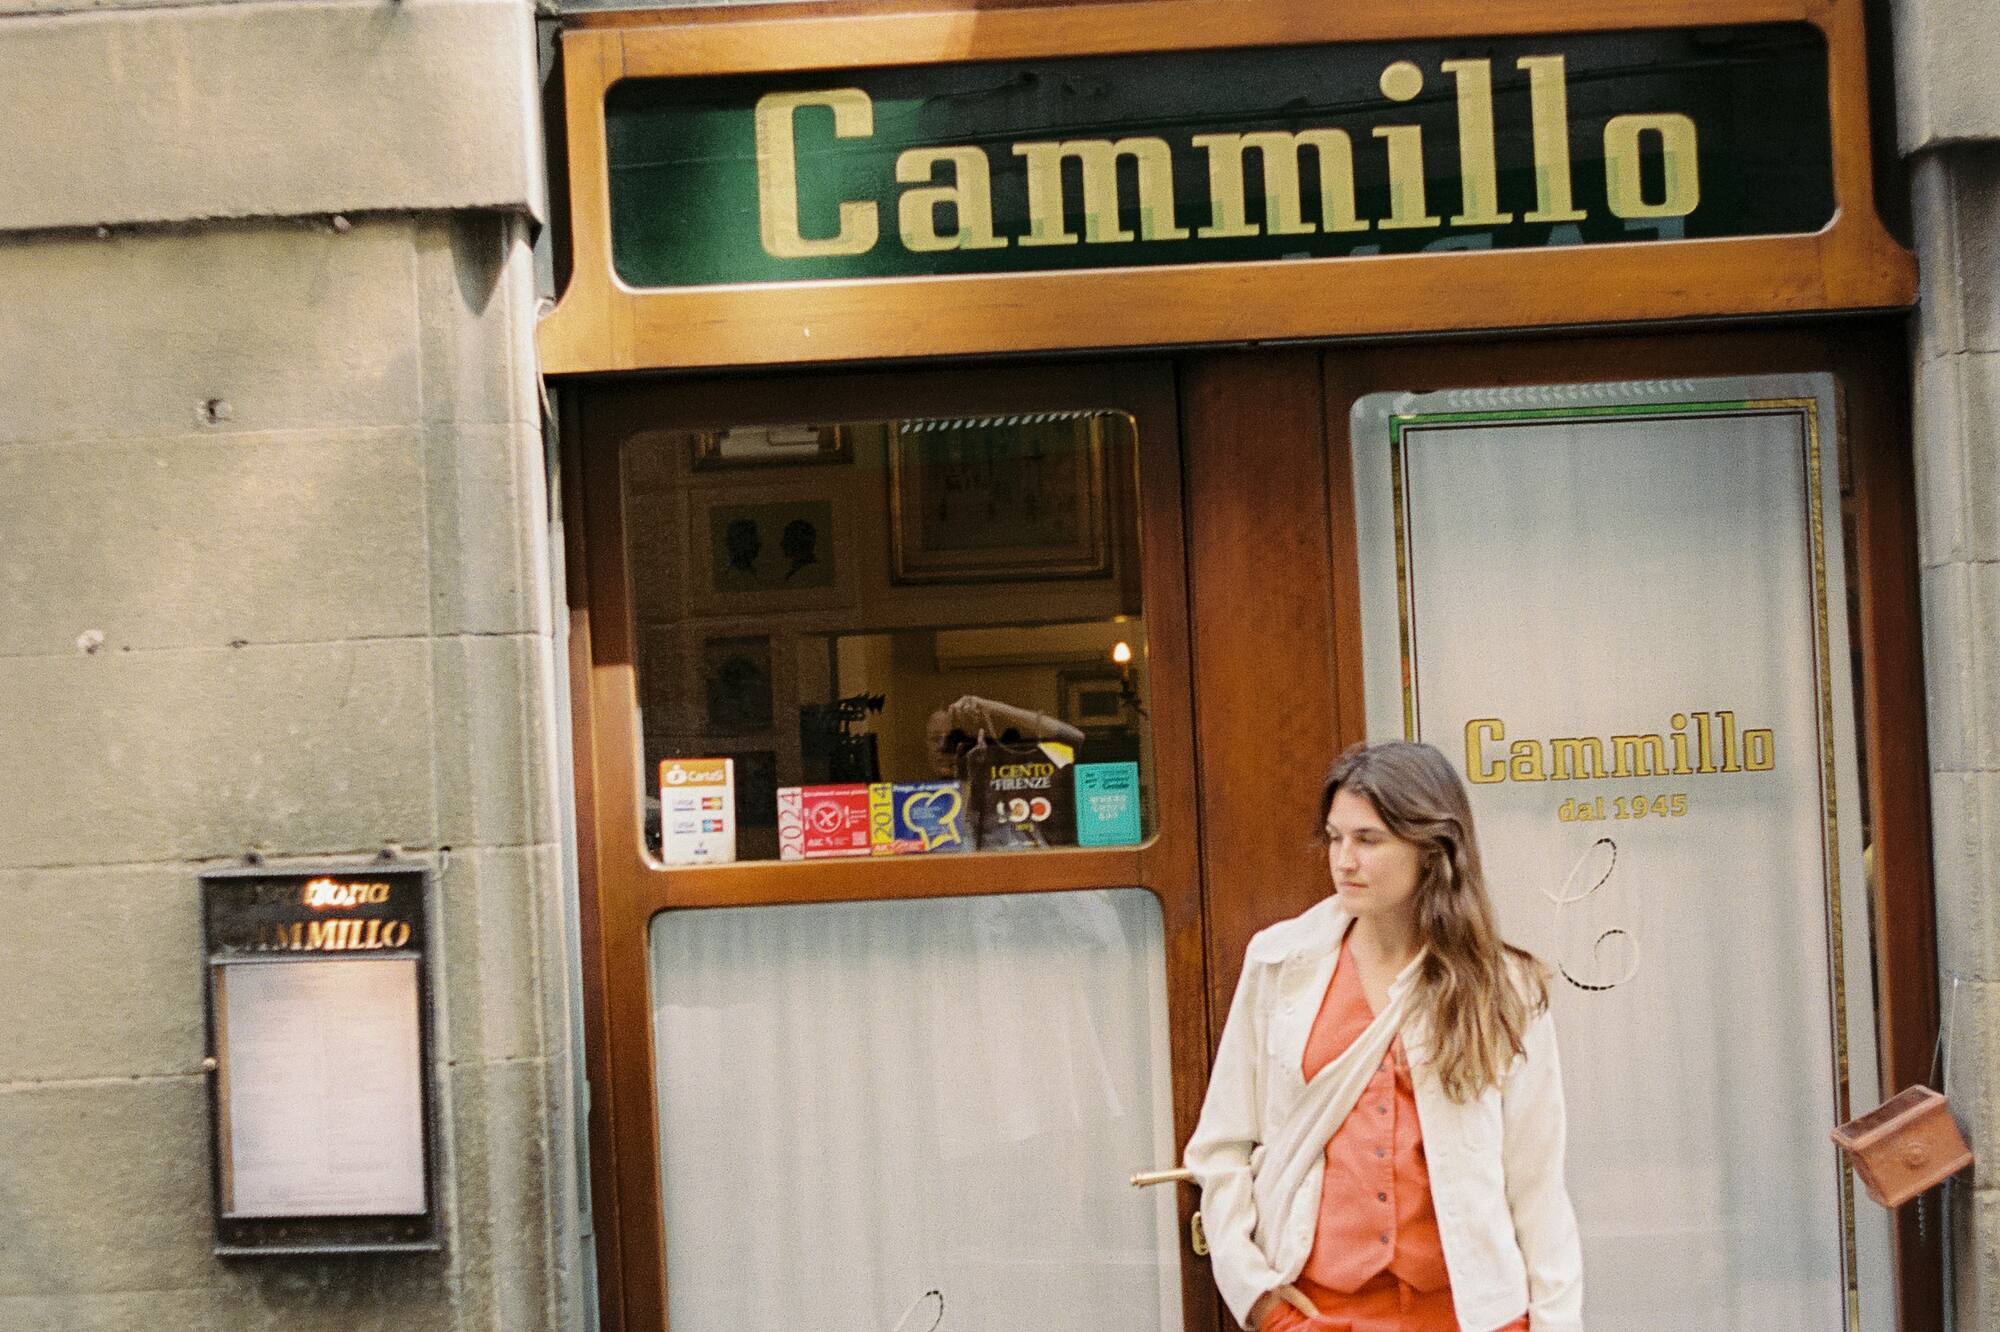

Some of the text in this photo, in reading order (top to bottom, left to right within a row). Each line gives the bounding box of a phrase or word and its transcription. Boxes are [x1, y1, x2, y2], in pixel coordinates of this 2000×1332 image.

[754, 54, 1702, 261] Cammillo
[998, 763, 1055, 779] CENTO
[1464, 710, 1776, 785] Cammillo
[1558, 794, 1689, 823] dal 1945
